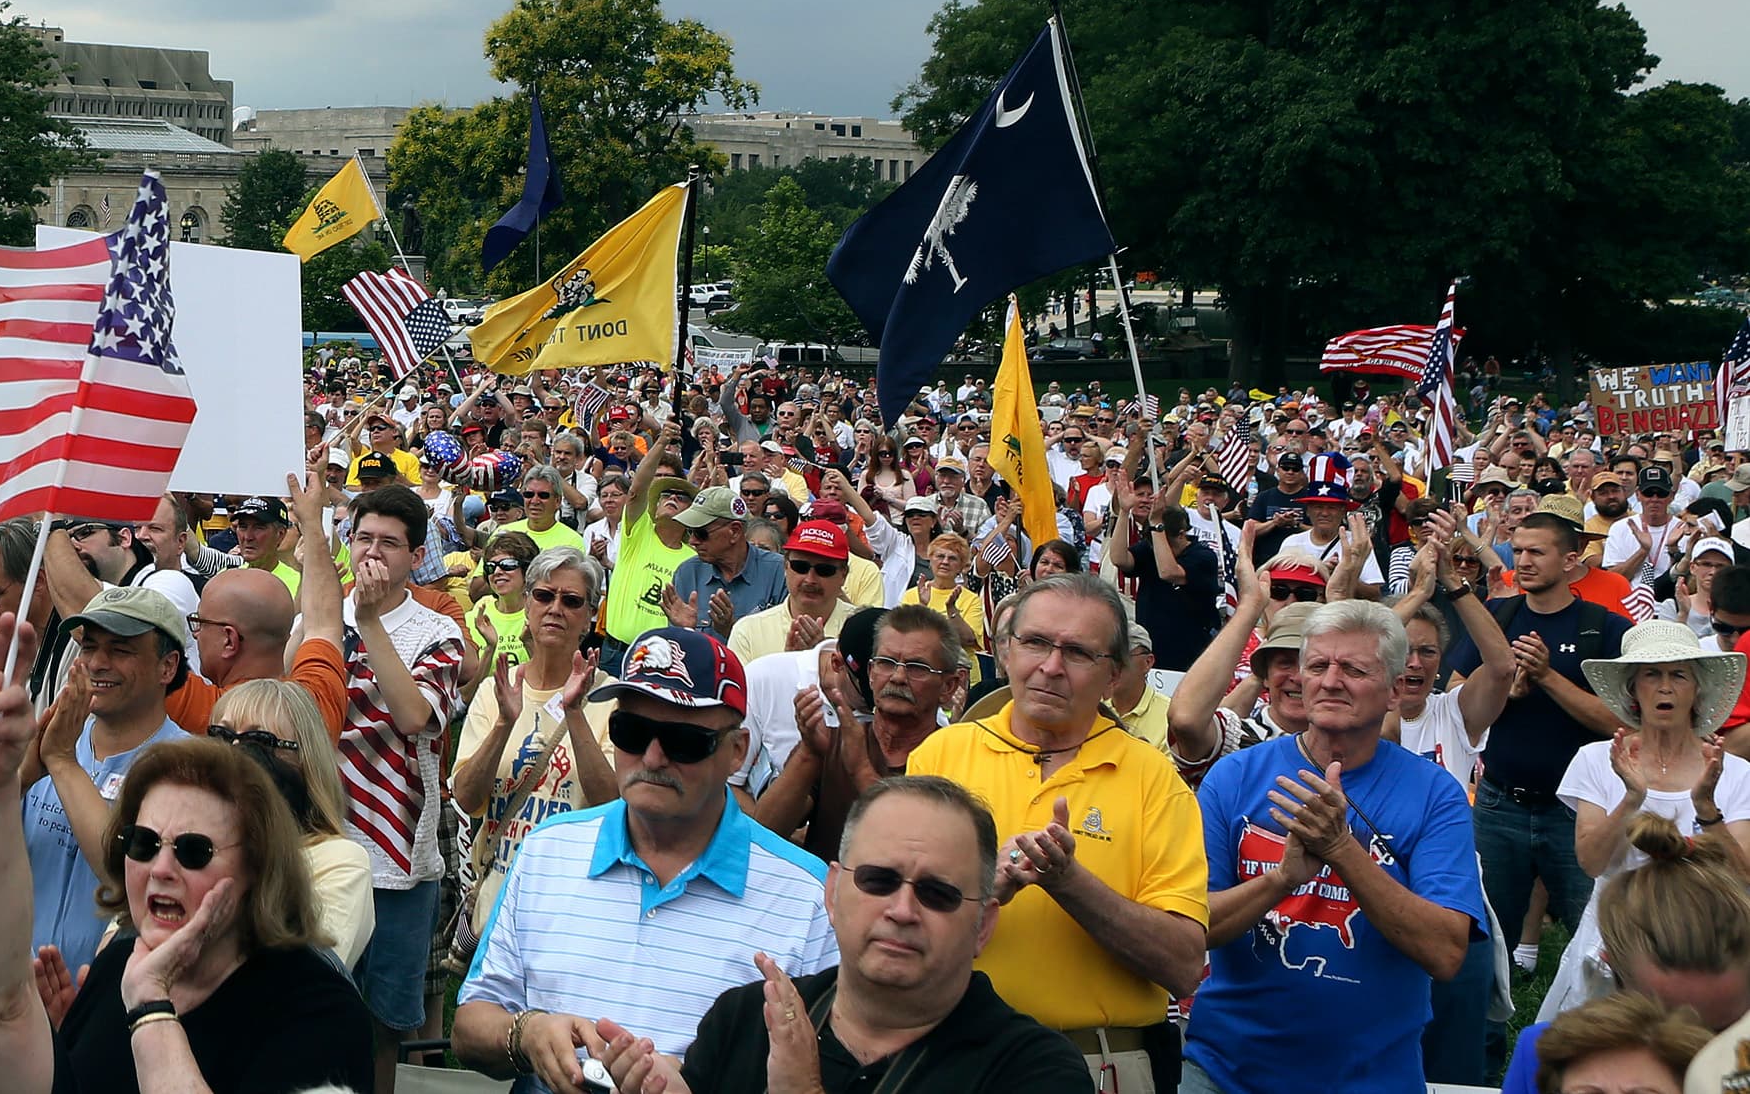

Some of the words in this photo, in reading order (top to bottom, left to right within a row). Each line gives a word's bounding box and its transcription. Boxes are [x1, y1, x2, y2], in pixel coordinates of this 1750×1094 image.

[1594, 366, 1640, 392] WE
[1649, 361, 1712, 387] WANT
[1612, 383, 1705, 409] TRUTH
[1596, 400, 1721, 436] BENGHAZI
[361, 459, 381, 468] NRA
[38, 817, 49, 826] to
[49, 821, 74, 838] peac
[1318, 882, 1350, 902] COME
